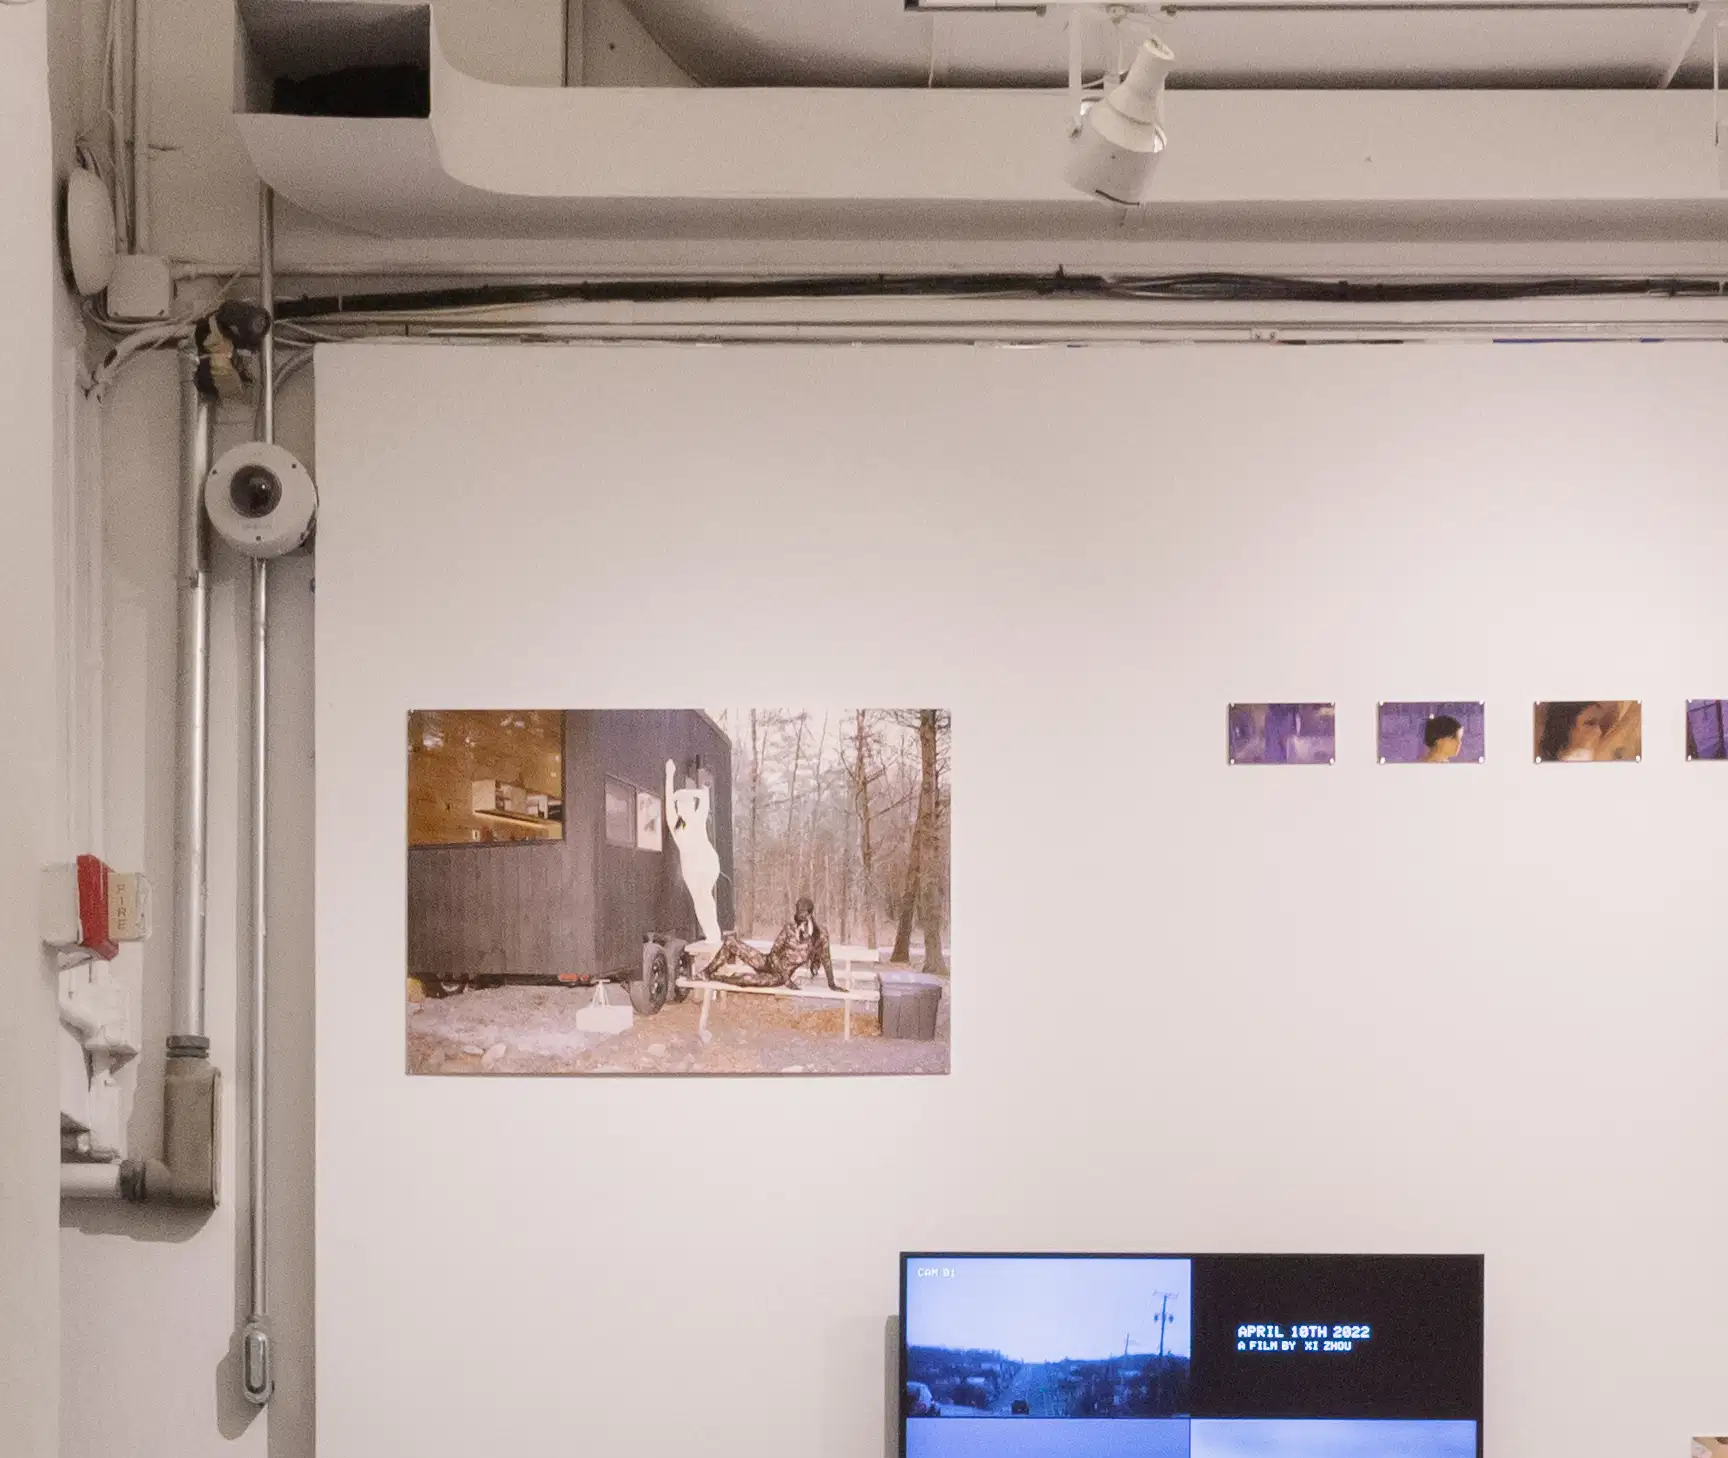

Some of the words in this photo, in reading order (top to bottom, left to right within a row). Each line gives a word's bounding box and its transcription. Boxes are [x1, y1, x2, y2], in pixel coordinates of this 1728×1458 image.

[116, 883, 127, 930] FIRE
[917, 1267, 939, 1277] CAM
[1237, 1325, 1284, 1338] APRIL
[1333, 1325, 1370, 1338] 2022
[1237, 1341, 1246, 1351] A
[1249, 1341, 1278, 1351] FILM
[1281, 1341, 1296, 1351] BY
[1304, 1341, 1319, 1351] XI
[1323, 1341, 1352, 1351] ZHOU
